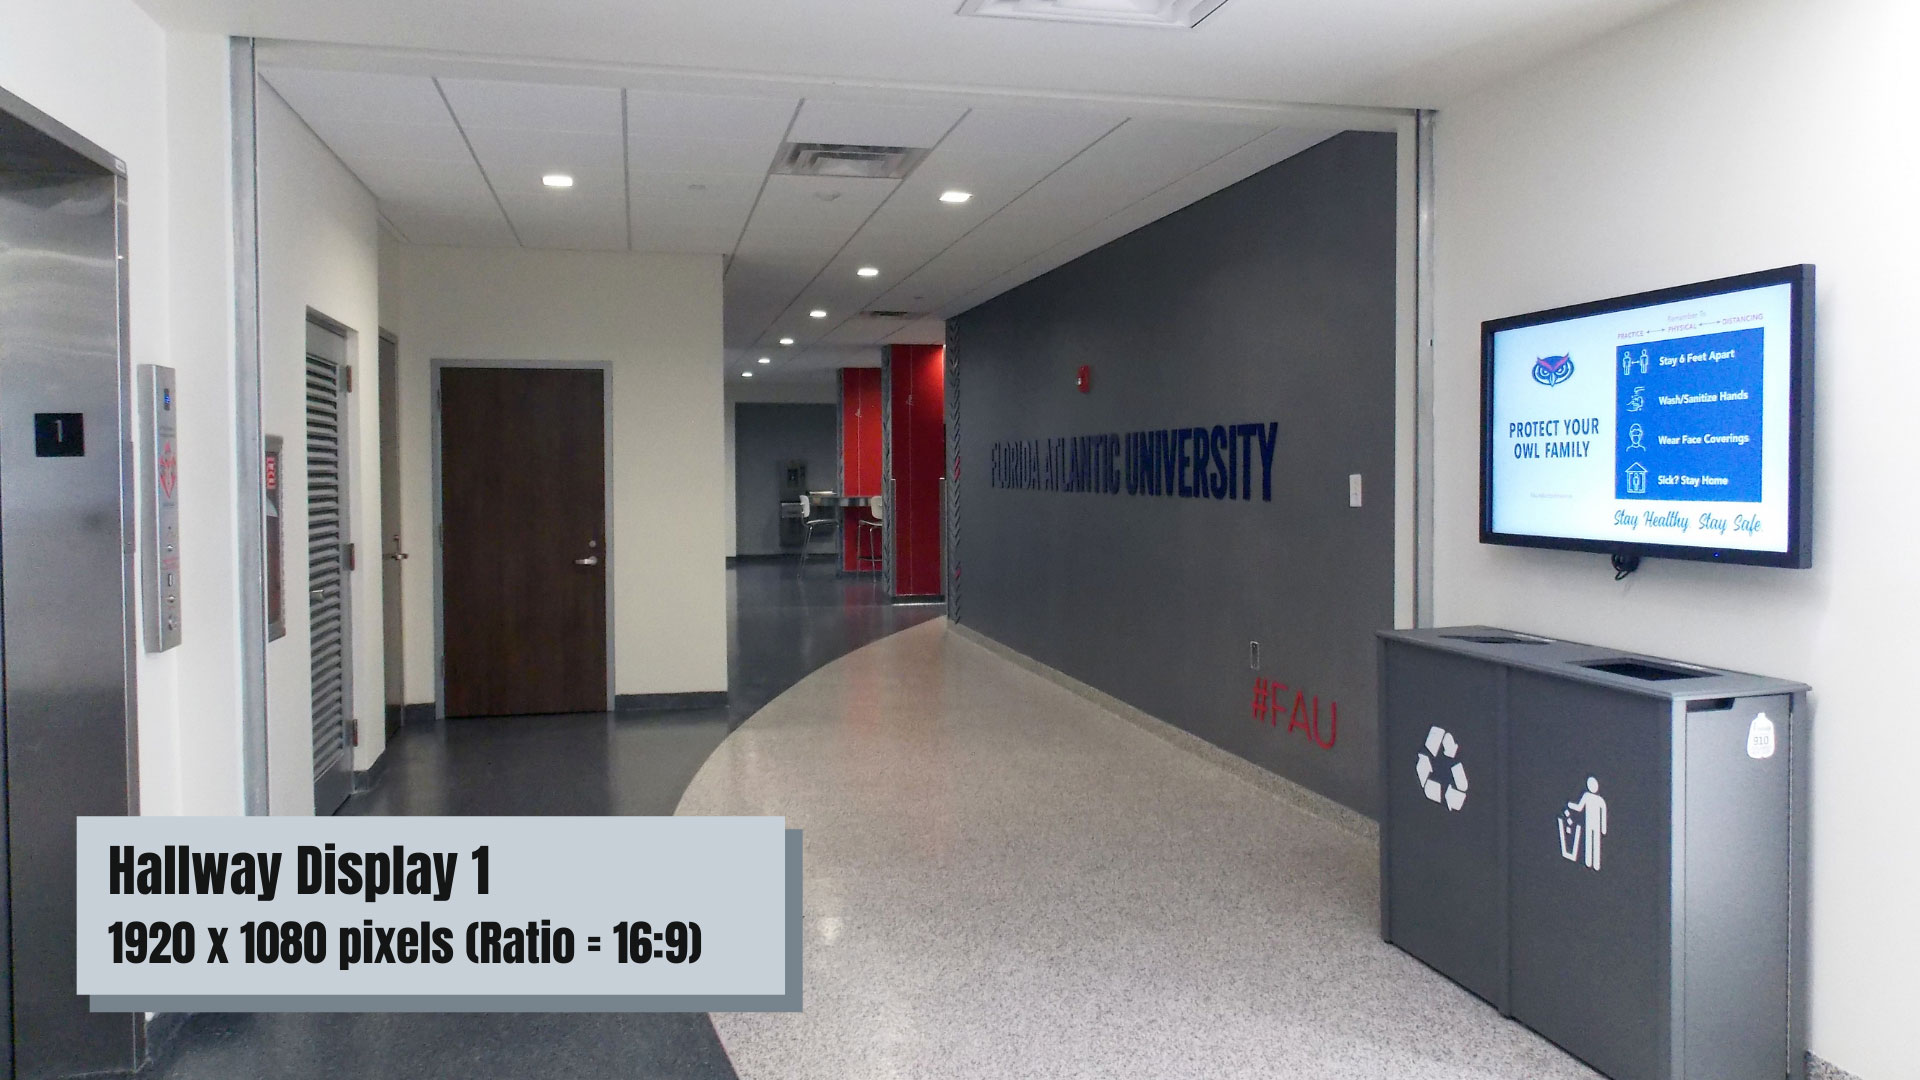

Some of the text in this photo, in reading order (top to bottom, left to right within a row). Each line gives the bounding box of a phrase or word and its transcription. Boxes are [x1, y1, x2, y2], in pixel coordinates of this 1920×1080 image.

[1617, 313, 1764, 340] PRACTICE PHYSICAL DISTANCING
[1659, 349, 1735, 367] Stay 6 Feet Apart
[1658, 390, 1749, 405] Wash/Sanitize Hands
[54, 419, 63, 443] 1
[1509, 418, 1599, 438] PROTECT YOUR
[1657, 433, 1750, 447] Wear Face Coverings
[1514, 441, 1590, 459] OWL FAMILY
[991, 422, 1279, 502] FLORIDA ATLANTIC UNIVERSITY
[1657, 474, 1728, 488] Sick? Stay Home
[1613, 509, 1638, 530] Stay
[1698, 512, 1727, 535] Stay
[1252, 676, 1338, 751] #FAU
[1753, 735, 1769, 746] 910
